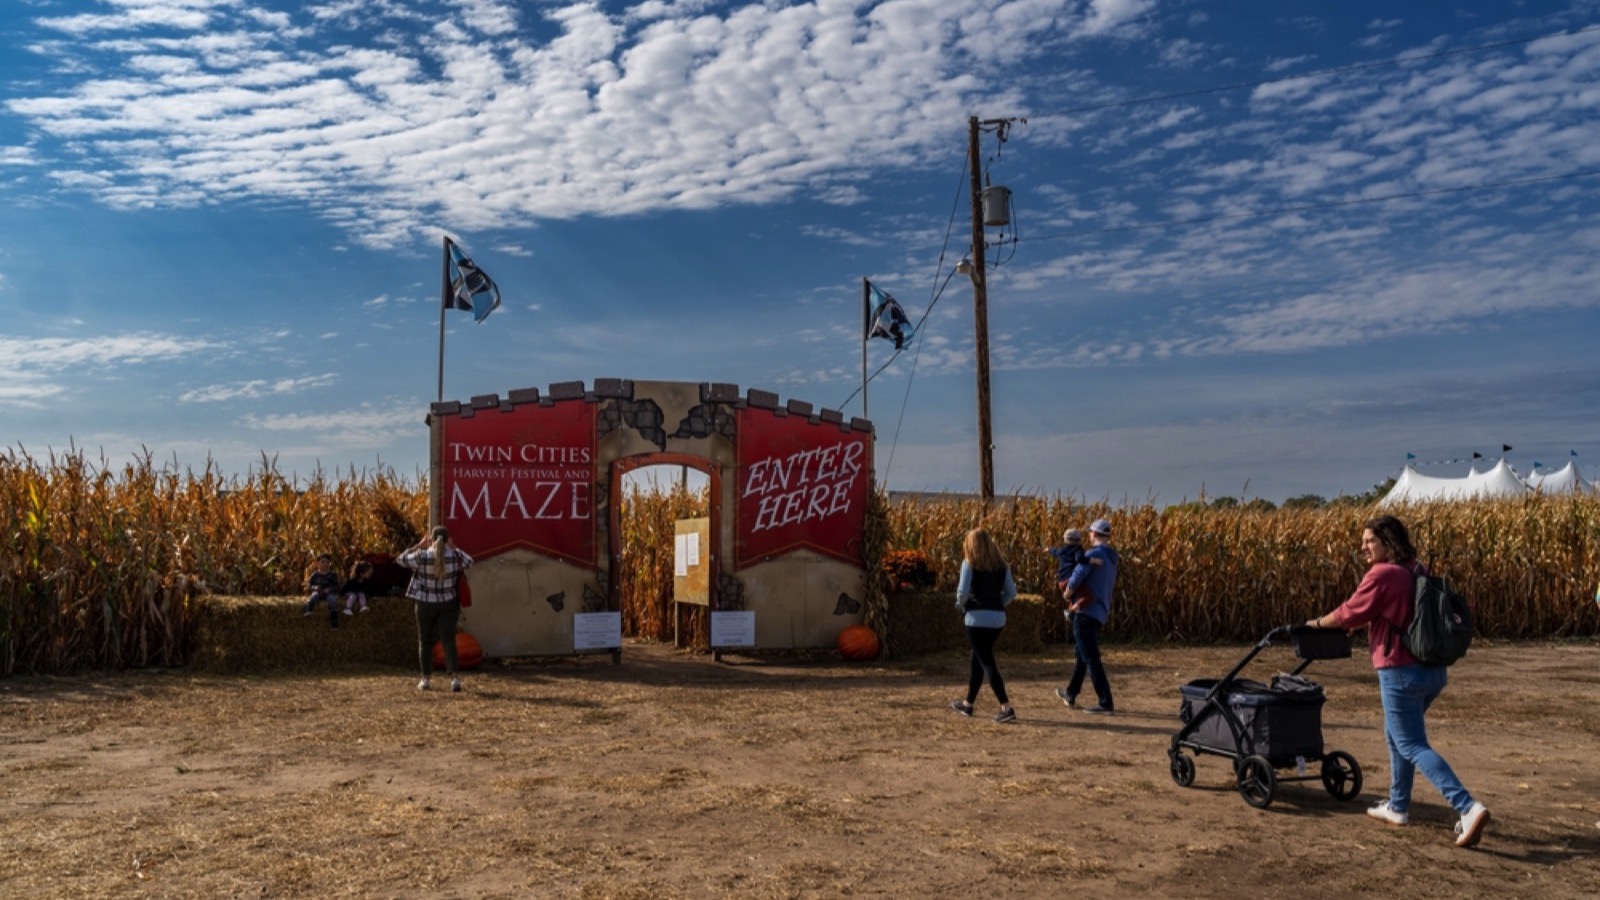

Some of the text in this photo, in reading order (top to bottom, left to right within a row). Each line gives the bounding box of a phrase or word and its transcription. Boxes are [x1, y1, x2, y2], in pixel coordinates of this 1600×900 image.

[450, 442, 590, 463] TWIN CITIES
[742, 441, 864, 498] ENTER
[453, 467, 590, 479] HARVEST FESTIVAL AND
[448, 480, 590, 519] MAZE
[751, 476, 854, 533] HERE
